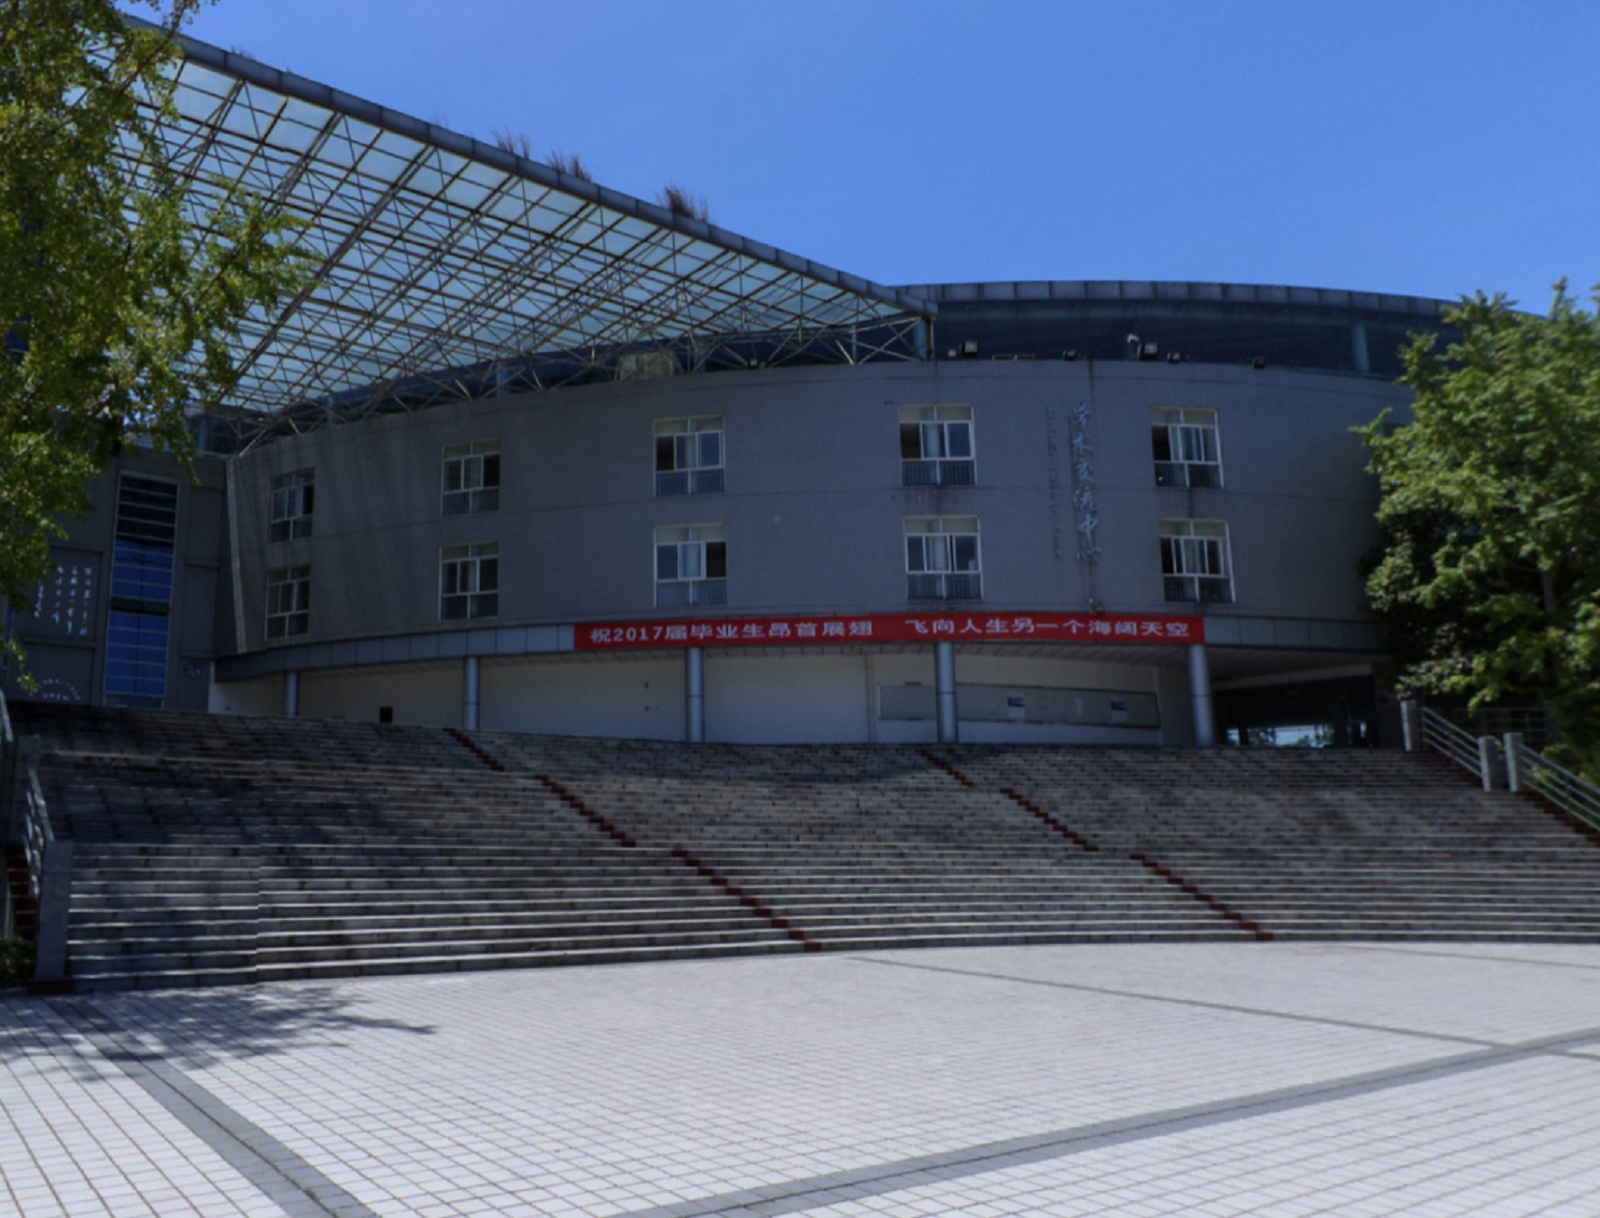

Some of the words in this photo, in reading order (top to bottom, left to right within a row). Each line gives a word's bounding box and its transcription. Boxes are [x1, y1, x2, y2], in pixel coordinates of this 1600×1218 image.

[1072, 402, 1102, 561] 学术交流中心
[590, 620, 873, 644] 祝2017届毕业生昂首展翅
[904, 617, 1190, 637] 飞向人生另一个海阔天空
